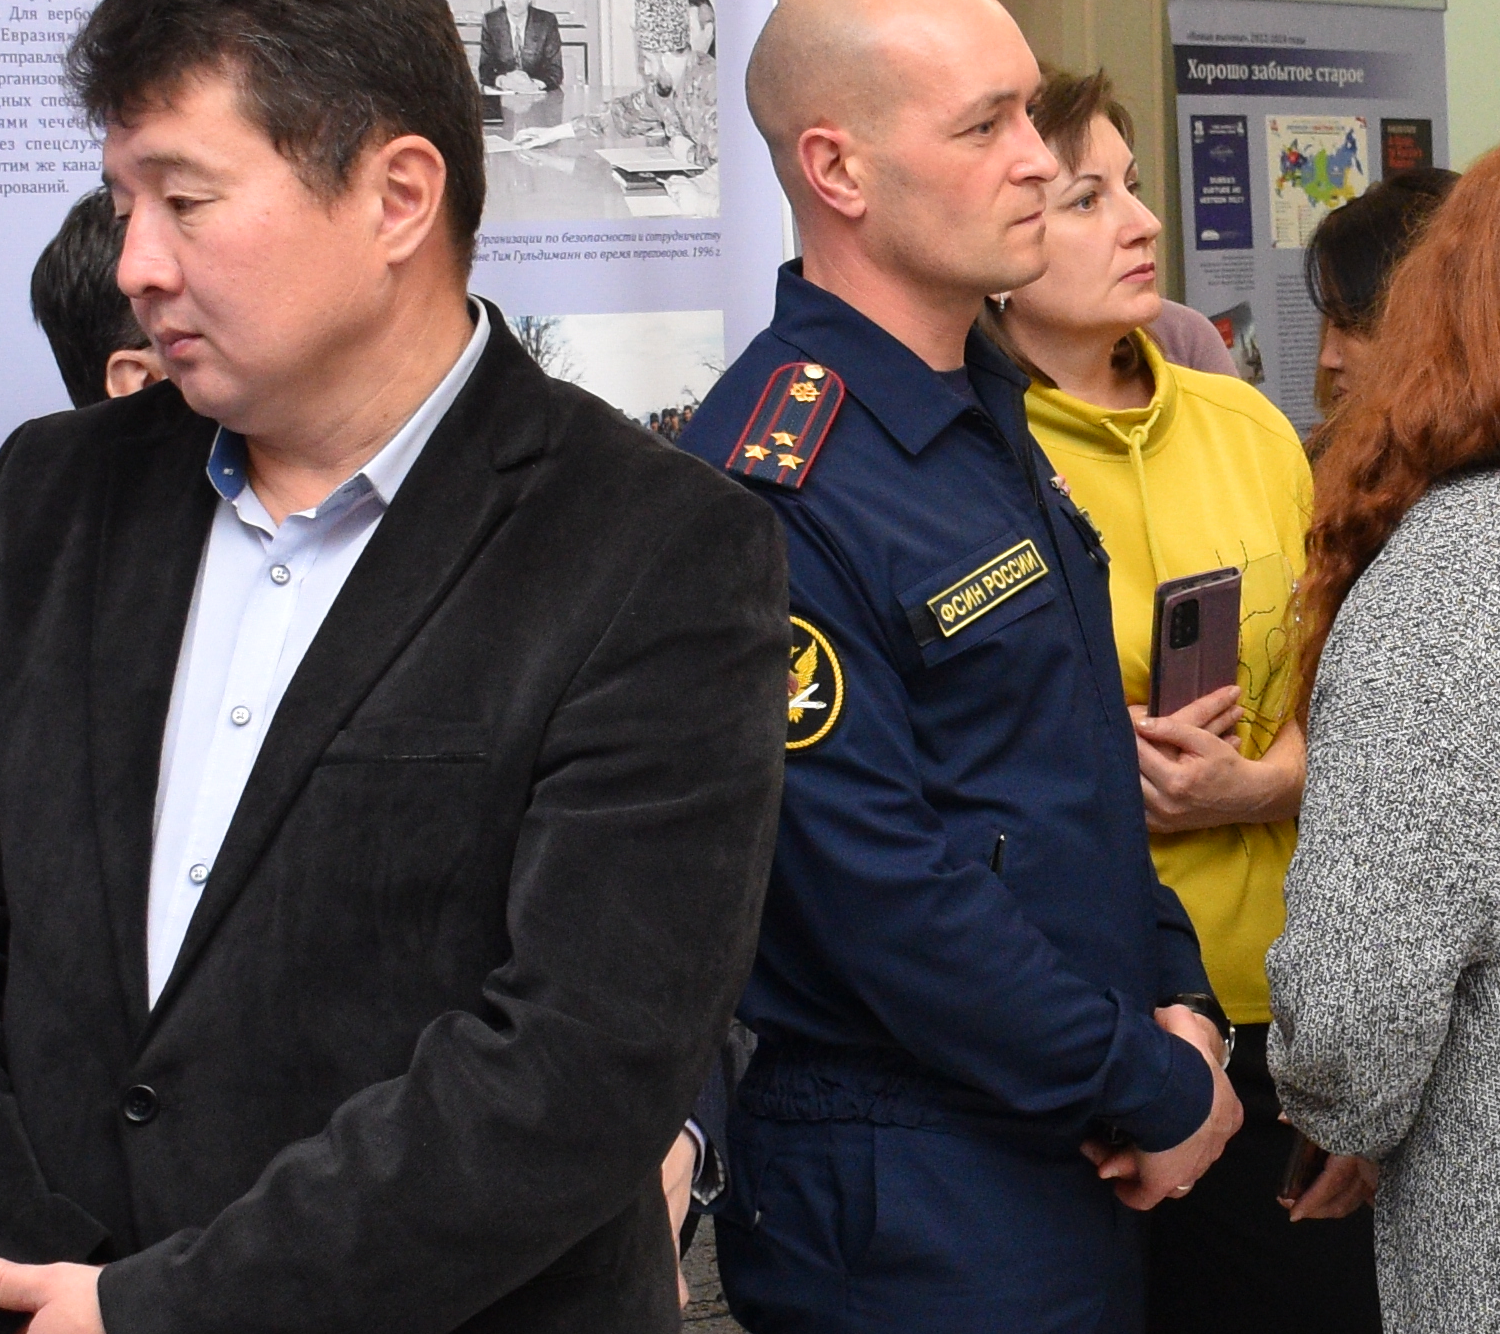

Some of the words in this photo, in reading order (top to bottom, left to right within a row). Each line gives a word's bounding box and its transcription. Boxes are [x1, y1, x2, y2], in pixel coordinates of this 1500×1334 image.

[1187, 58, 1249, 85] Хорошо
[1251, 60, 1313, 82] забытое
[1315, 66, 1365, 88] старое
[545, 233, 560, 244] по
[561, 231, 637, 244] безопасности
[644, 228, 722, 245] сотрудничеству
[491, 249, 512, 263] Тим
[513, 248, 582, 265] Гульдиманн
[583, 250, 598, 261] во
[599, 249, 632, 263] время
[692, 245, 714, 259] 1996
[940, 583, 987, 624] ФСИН
[981, 550, 1039, 596] РОССИИ
